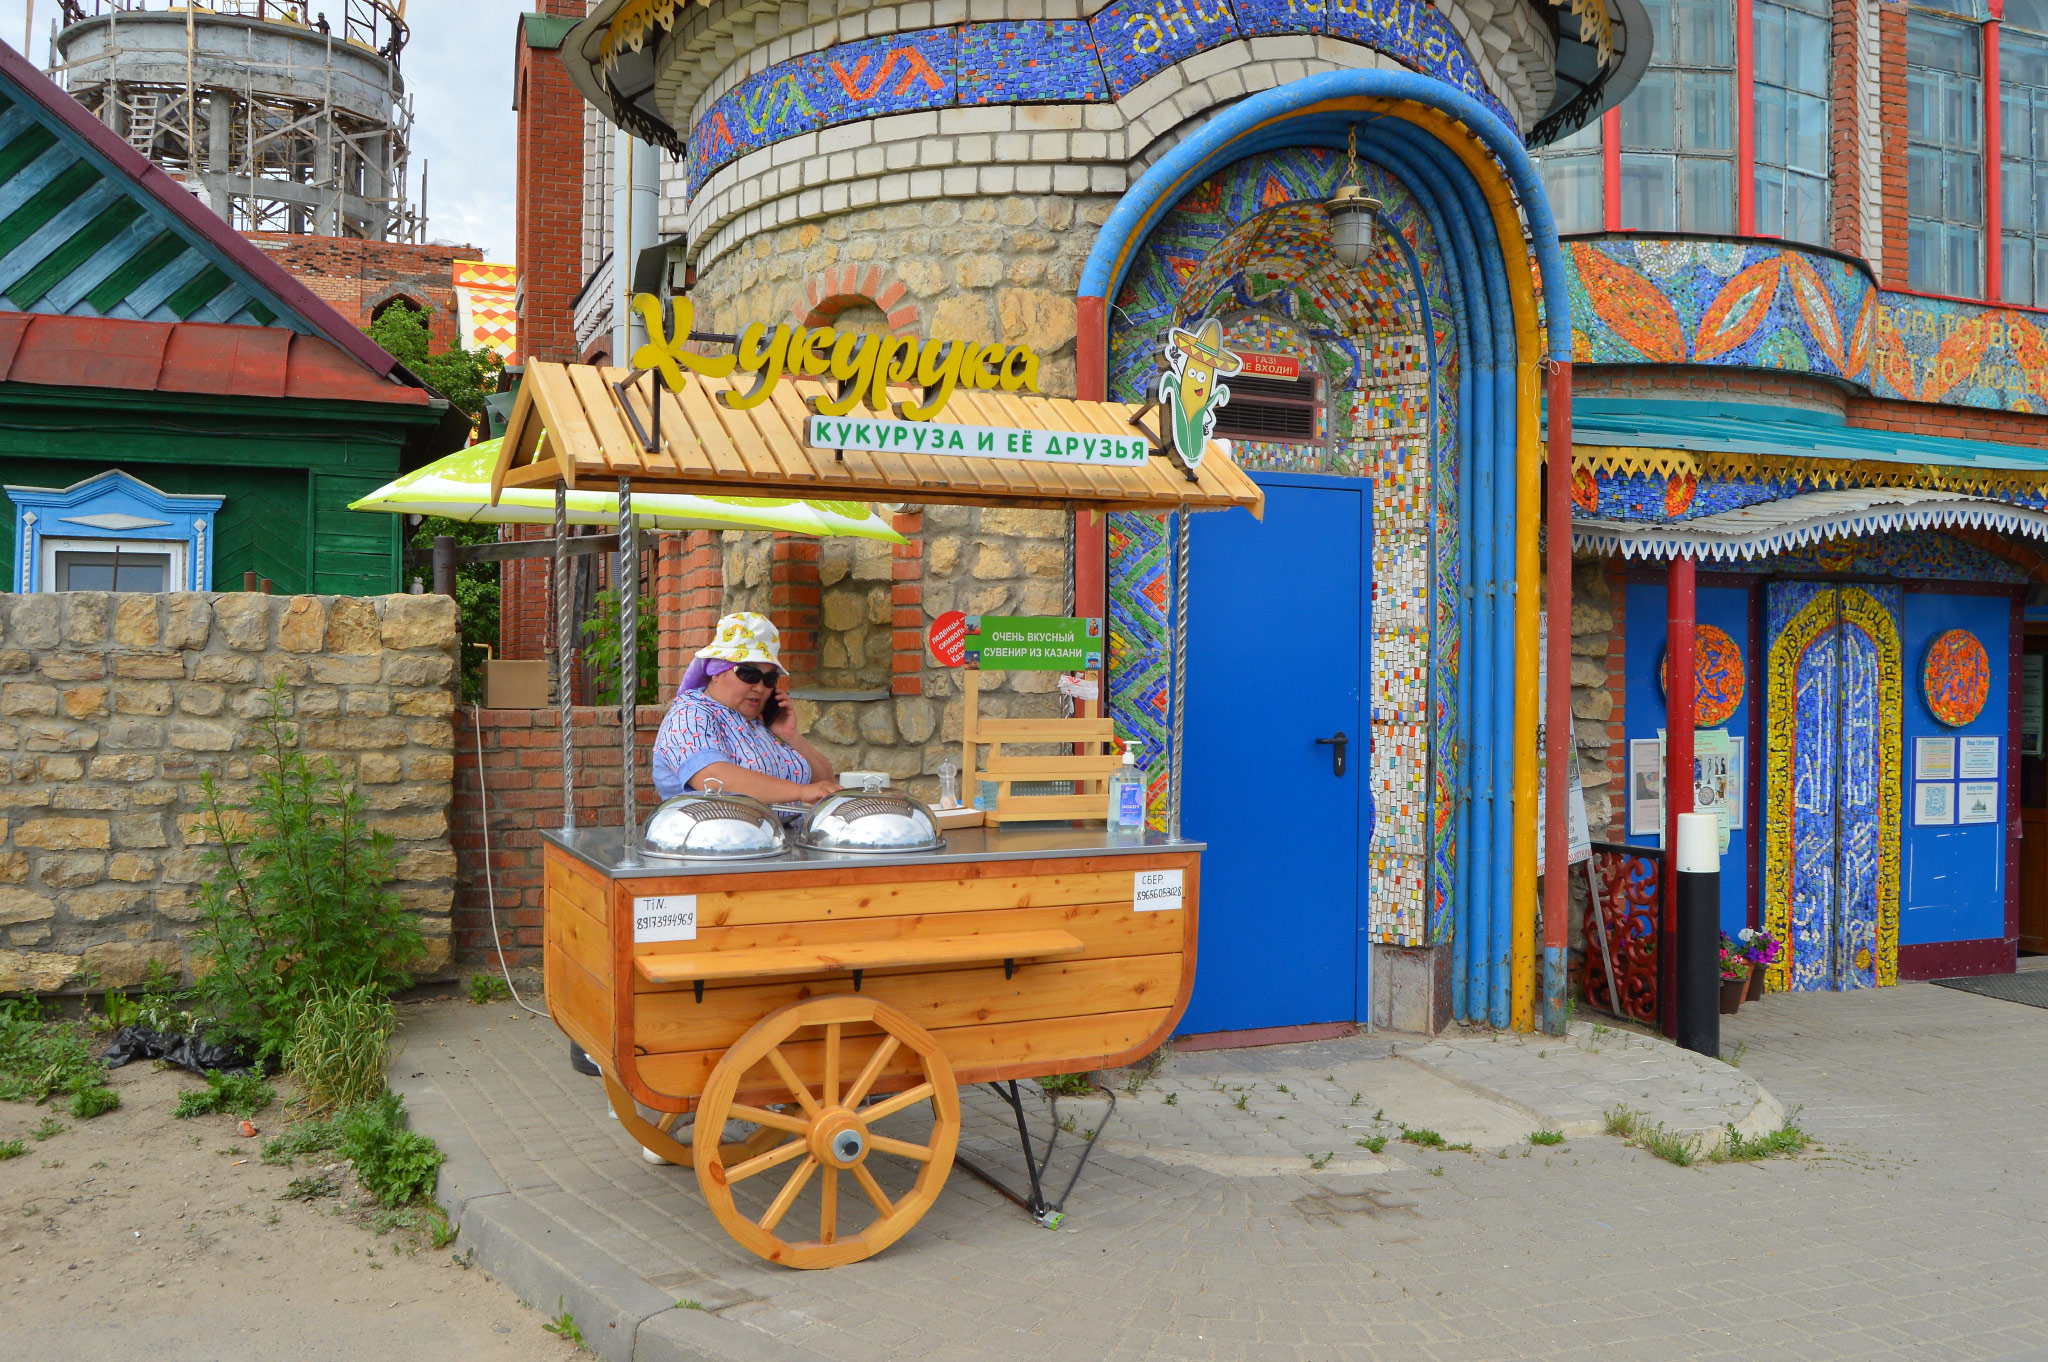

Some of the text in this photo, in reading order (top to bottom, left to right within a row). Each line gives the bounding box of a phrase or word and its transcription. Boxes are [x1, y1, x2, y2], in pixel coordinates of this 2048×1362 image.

[1877, 305, 2024, 350] БОГАТСТВО
[631, 291, 1040, 422] Кукурука
[1255, 355, 1277, 365] ГАЗ!
[1255, 363, 1293, 375] ВХОДИ!
[816, 421, 1145, 460] КУКУРУЗА И ЕЁ ДРУЗЬЯ
[992, 631, 1075, 642] ОЧЕНЬ ВКУСНЫЙ
[983, 647, 1082, 658] СУВЕНИР ИЗ КАЗАНИ
[636, 912, 694, 930] 89173994969
